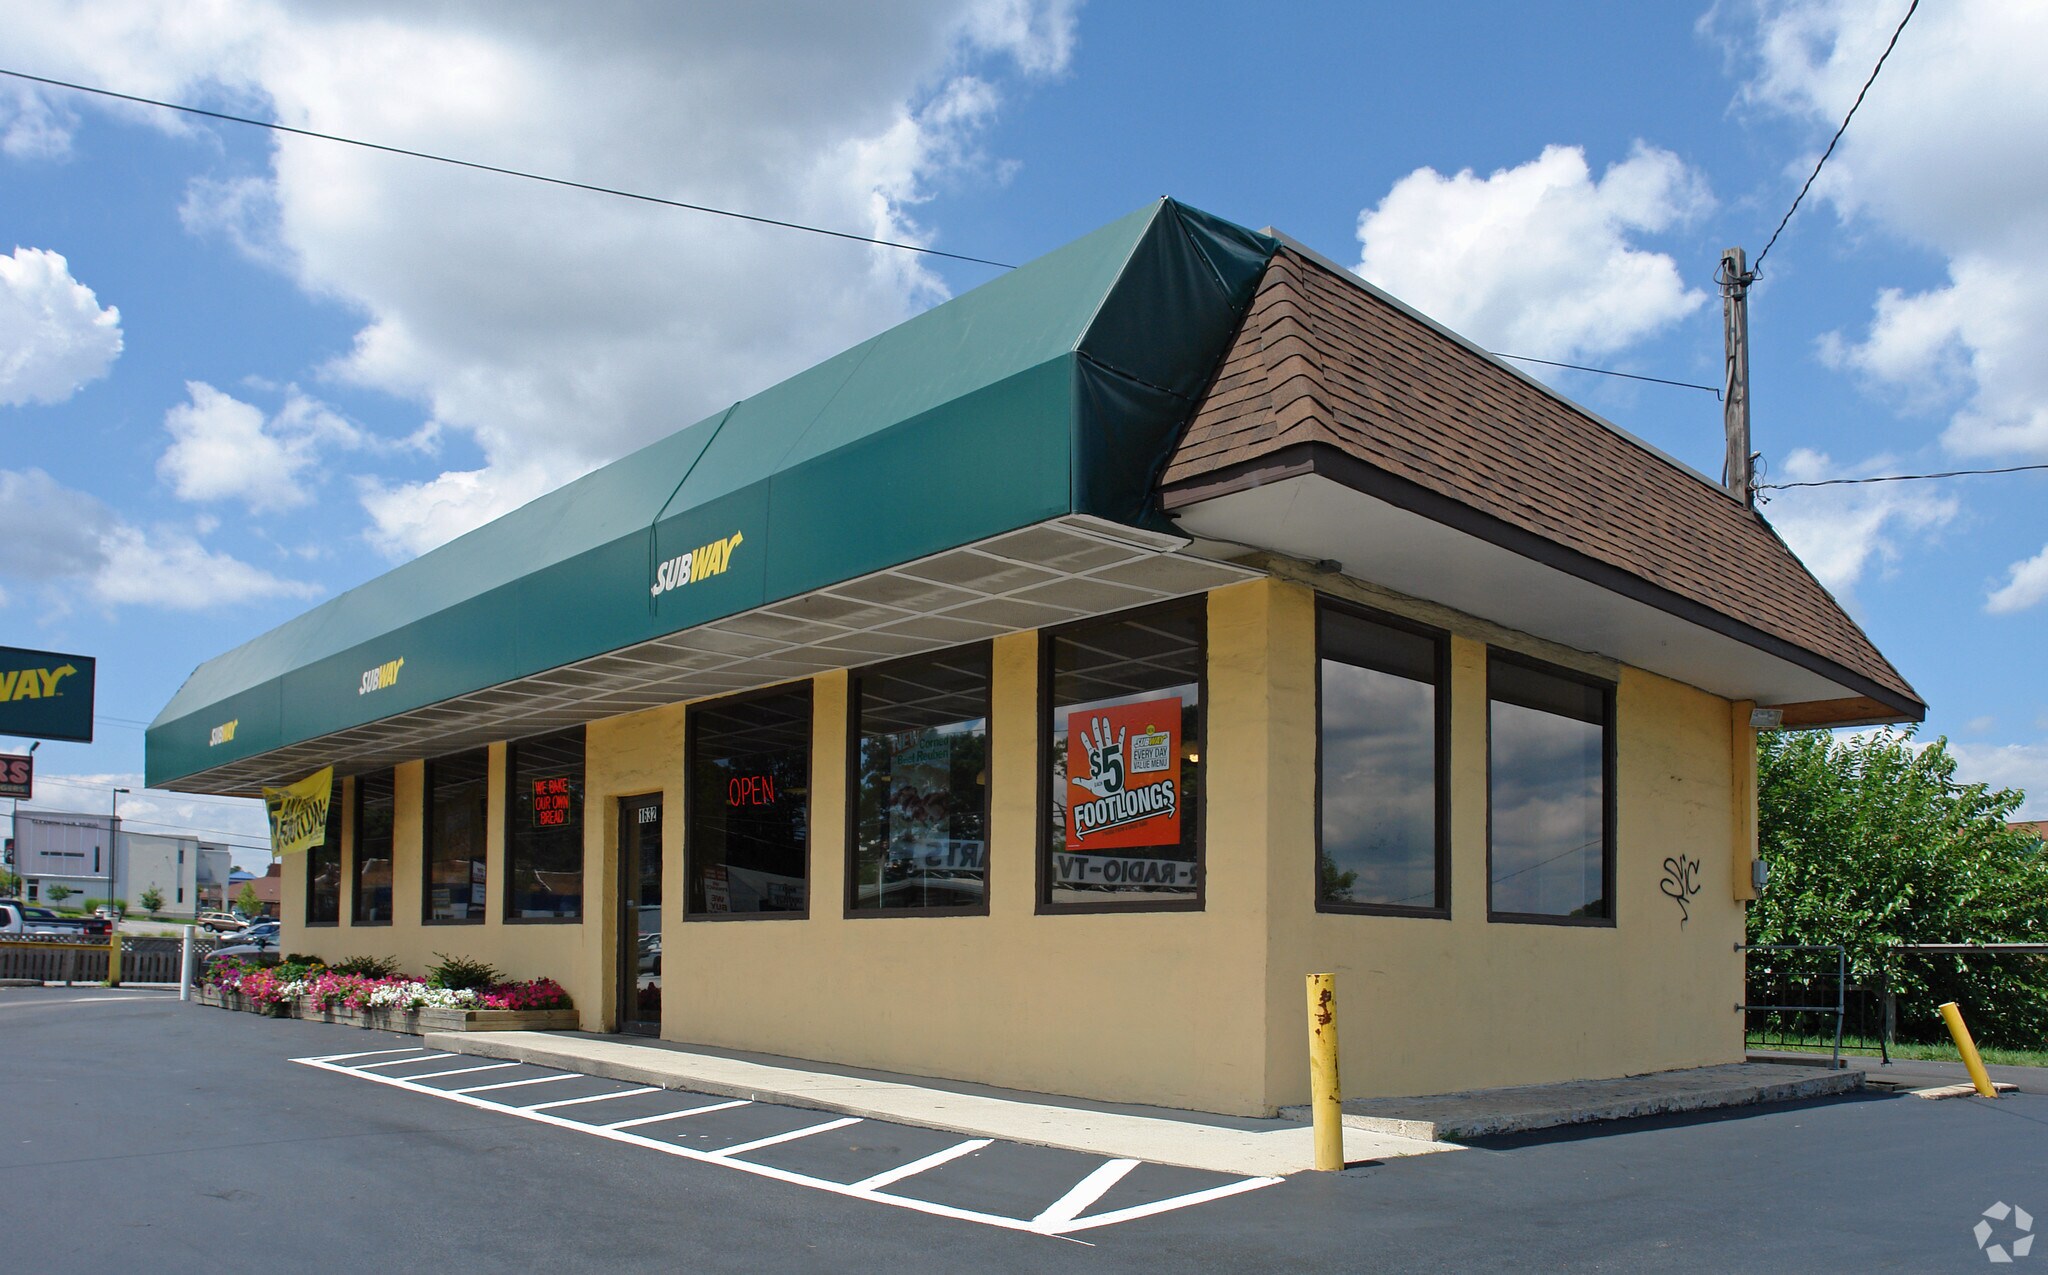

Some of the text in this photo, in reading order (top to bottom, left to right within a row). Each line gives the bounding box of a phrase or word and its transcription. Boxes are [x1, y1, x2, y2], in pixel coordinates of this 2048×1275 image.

[651, 530, 743, 598] SUBWAY
[359, 656, 404, 695] SUBWAY
[209, 718, 238, 747] SUBWAY
[919, 736, 949, 749] Corned
[1134, 735, 1168, 748] SUBWAY
[916, 750, 949, 763] Reuben
[1133, 746, 1168, 760] EVERY DAY
[1091, 744, 1124, 793] $5
[1133, 758, 1168, 770] VALUE MENU
[535, 777, 568, 795] WE BAKE
[729, 775, 775, 807] OPEN
[535, 795, 569, 811] OUR OWN
[1074, 779, 1175, 829] FOOTLONGS
[540, 809, 564, 826] BREAD
[639, 806, 657, 823] 1632
